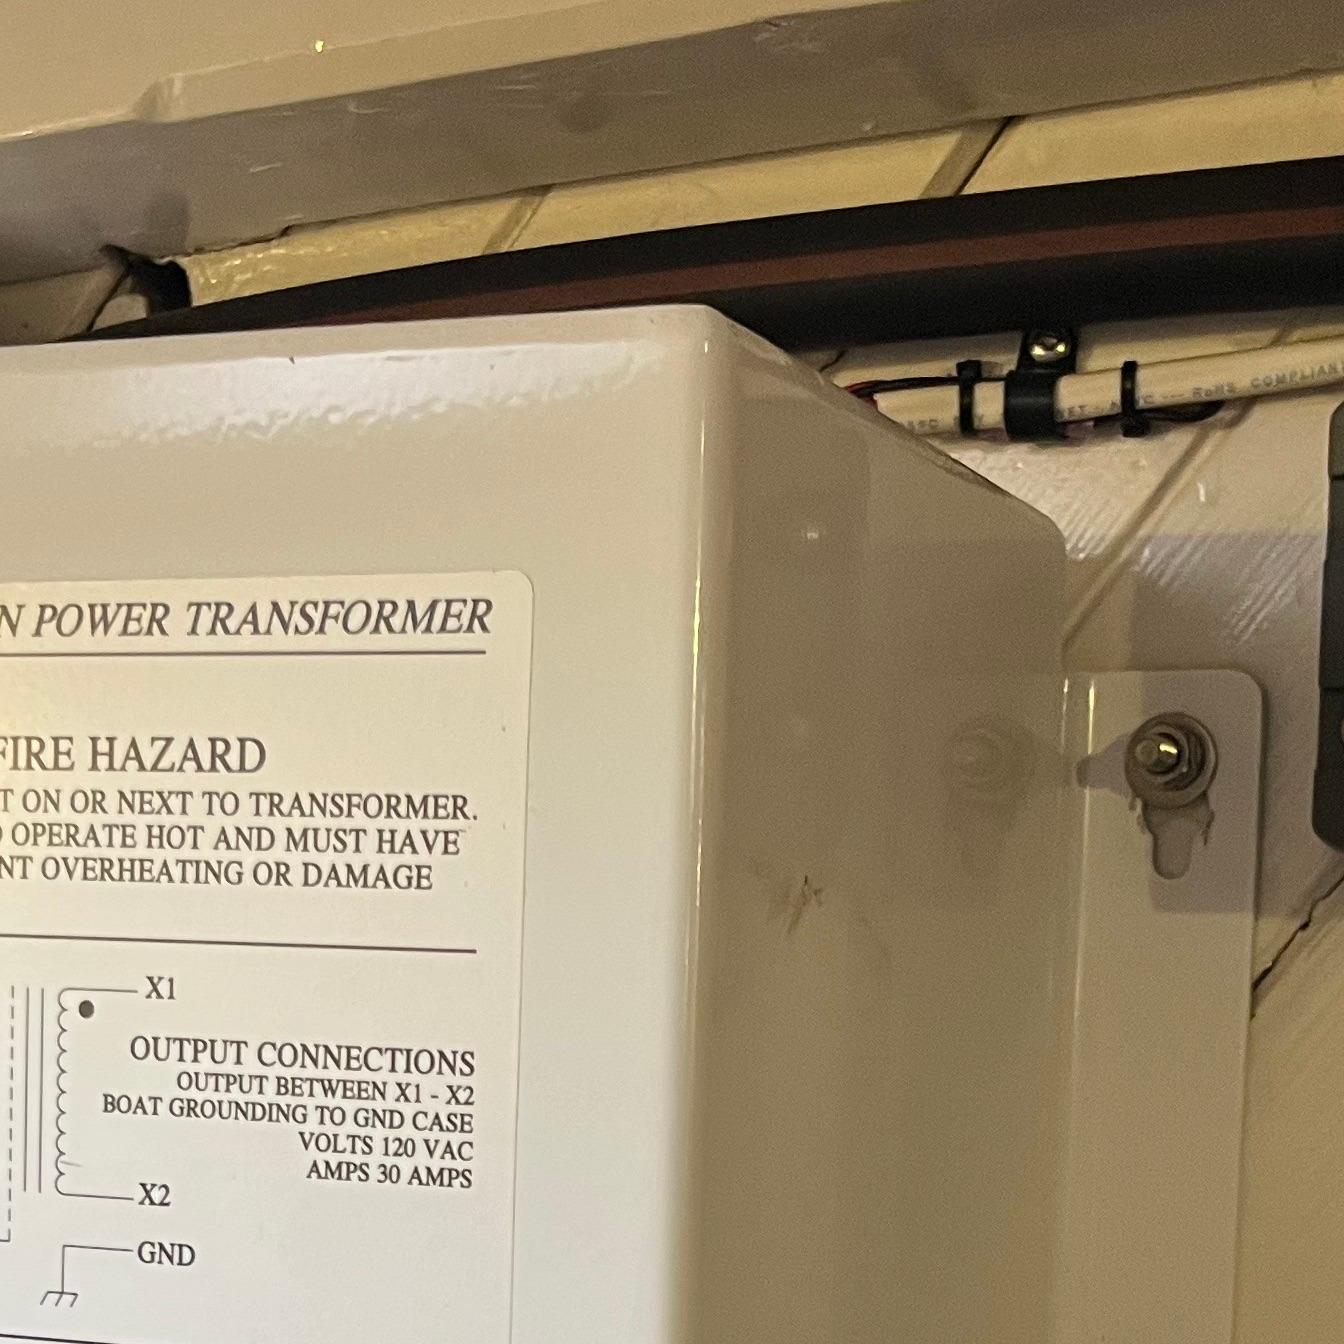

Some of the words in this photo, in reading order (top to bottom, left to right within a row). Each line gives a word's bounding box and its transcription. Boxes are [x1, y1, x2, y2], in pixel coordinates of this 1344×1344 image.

[31, 601, 171, 638] POWER
[186, 597, 494, 637] TRANSFORMER
[87, 735, 267, 774] HAZARD
[21, 788, 62, 814] ON
[69, 788, 110, 815] OR
[116, 788, 195, 817] NEXT
[201, 790, 240, 817] TO
[247, 791, 478, 821] TRANSFORMER.
[10, 821, 138, 849] OPERATE
[145, 823, 206, 851] HOT
[212, 825, 276, 852] AND
[283, 826, 368, 854] MUST
[375, 827, 461, 856] HAVE
[40, 855, 245, 886] OVERHEATING
[252, 860, 294, 888] OR
[301, 861, 434, 891] DAMAGE
[144, 975, 177, 1001] X1
[129, 1035, 249, 1066] OUTPUT
[256, 1040, 476, 1078] CONNECTIONS
[176, 1070, 270, 1096] OUTPUT
[274, 1075, 389, 1102] BETWEEN
[394, 1080, 422, 1104] X1
[444, 1084, 476, 1107] X2
[101, 1092, 164, 1117] BOAT
[168, 1096, 309, 1125] GROUNDING
[314, 1104, 347, 1127] TO
[352, 1106, 406, 1130] GND
[411, 1110, 474, 1134] CASE
[297, 1130, 374, 1156] VOLTS
[381, 1136, 417, 1159] 120
[422, 1137, 474, 1162] VAC
[305, 1159, 371, 1183] AMPS
[376, 1163, 402, 1185] 30
[406, 1164, 473, 1190] AMPS
[137, 1181, 172, 1208] X2
[136, 1240, 196, 1267] GND
